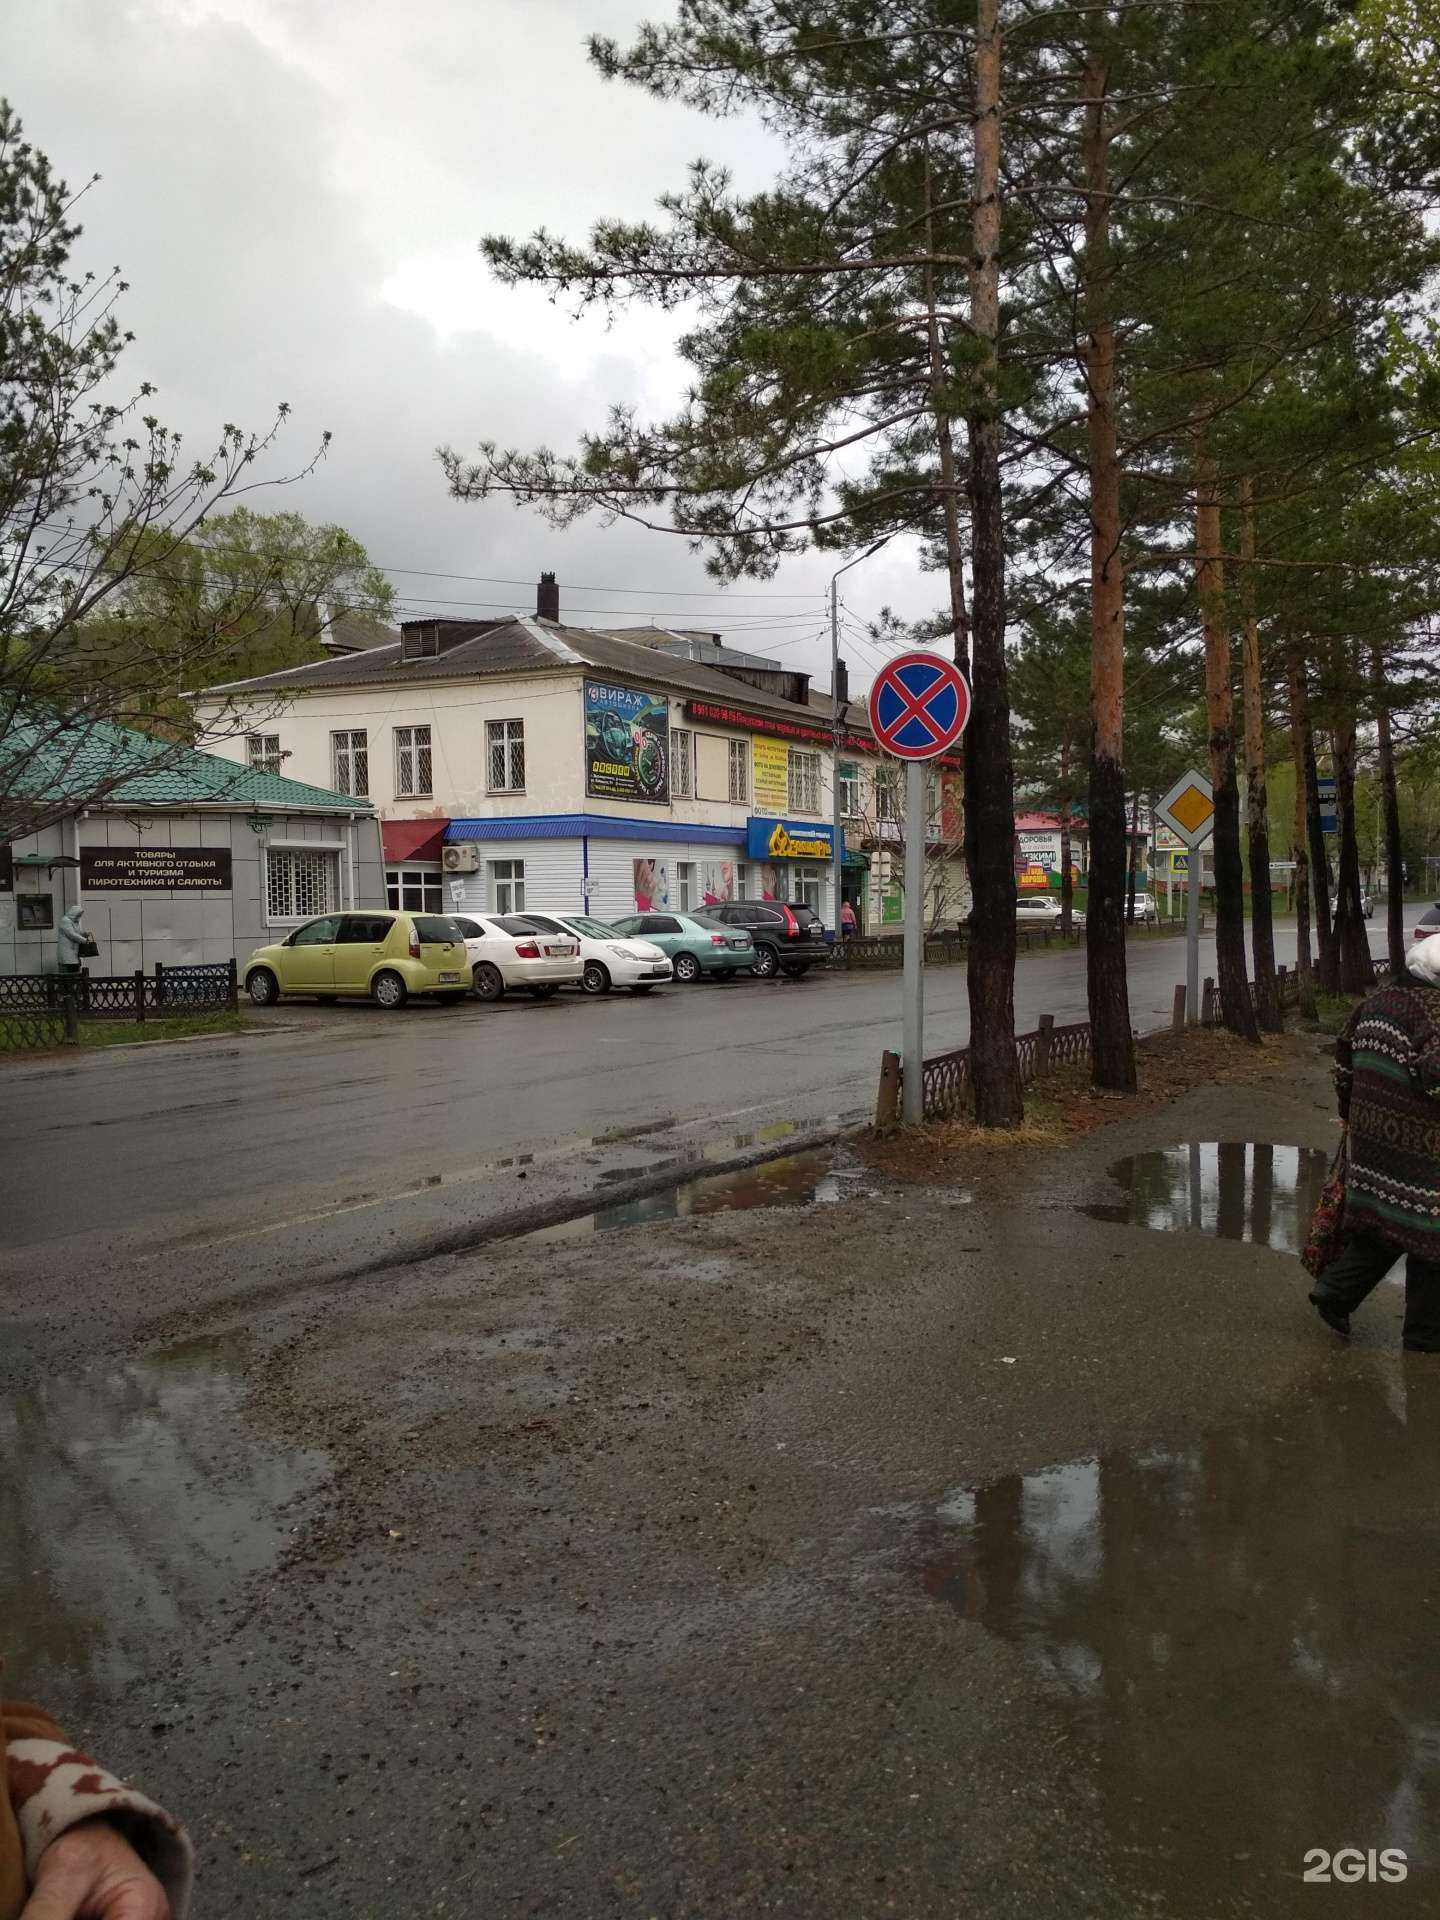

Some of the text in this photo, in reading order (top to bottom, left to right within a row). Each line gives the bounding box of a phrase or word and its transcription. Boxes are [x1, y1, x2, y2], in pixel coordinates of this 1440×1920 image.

[599, 687, 643, 706] ВИРАЖ
[135, 851, 176, 859] ТОВАРЫ
[94, 860, 216, 868] ДЛЯ АКТИВНОГО ОТДЫХА
[177, 878, 222, 886] САЛЮТЫ
